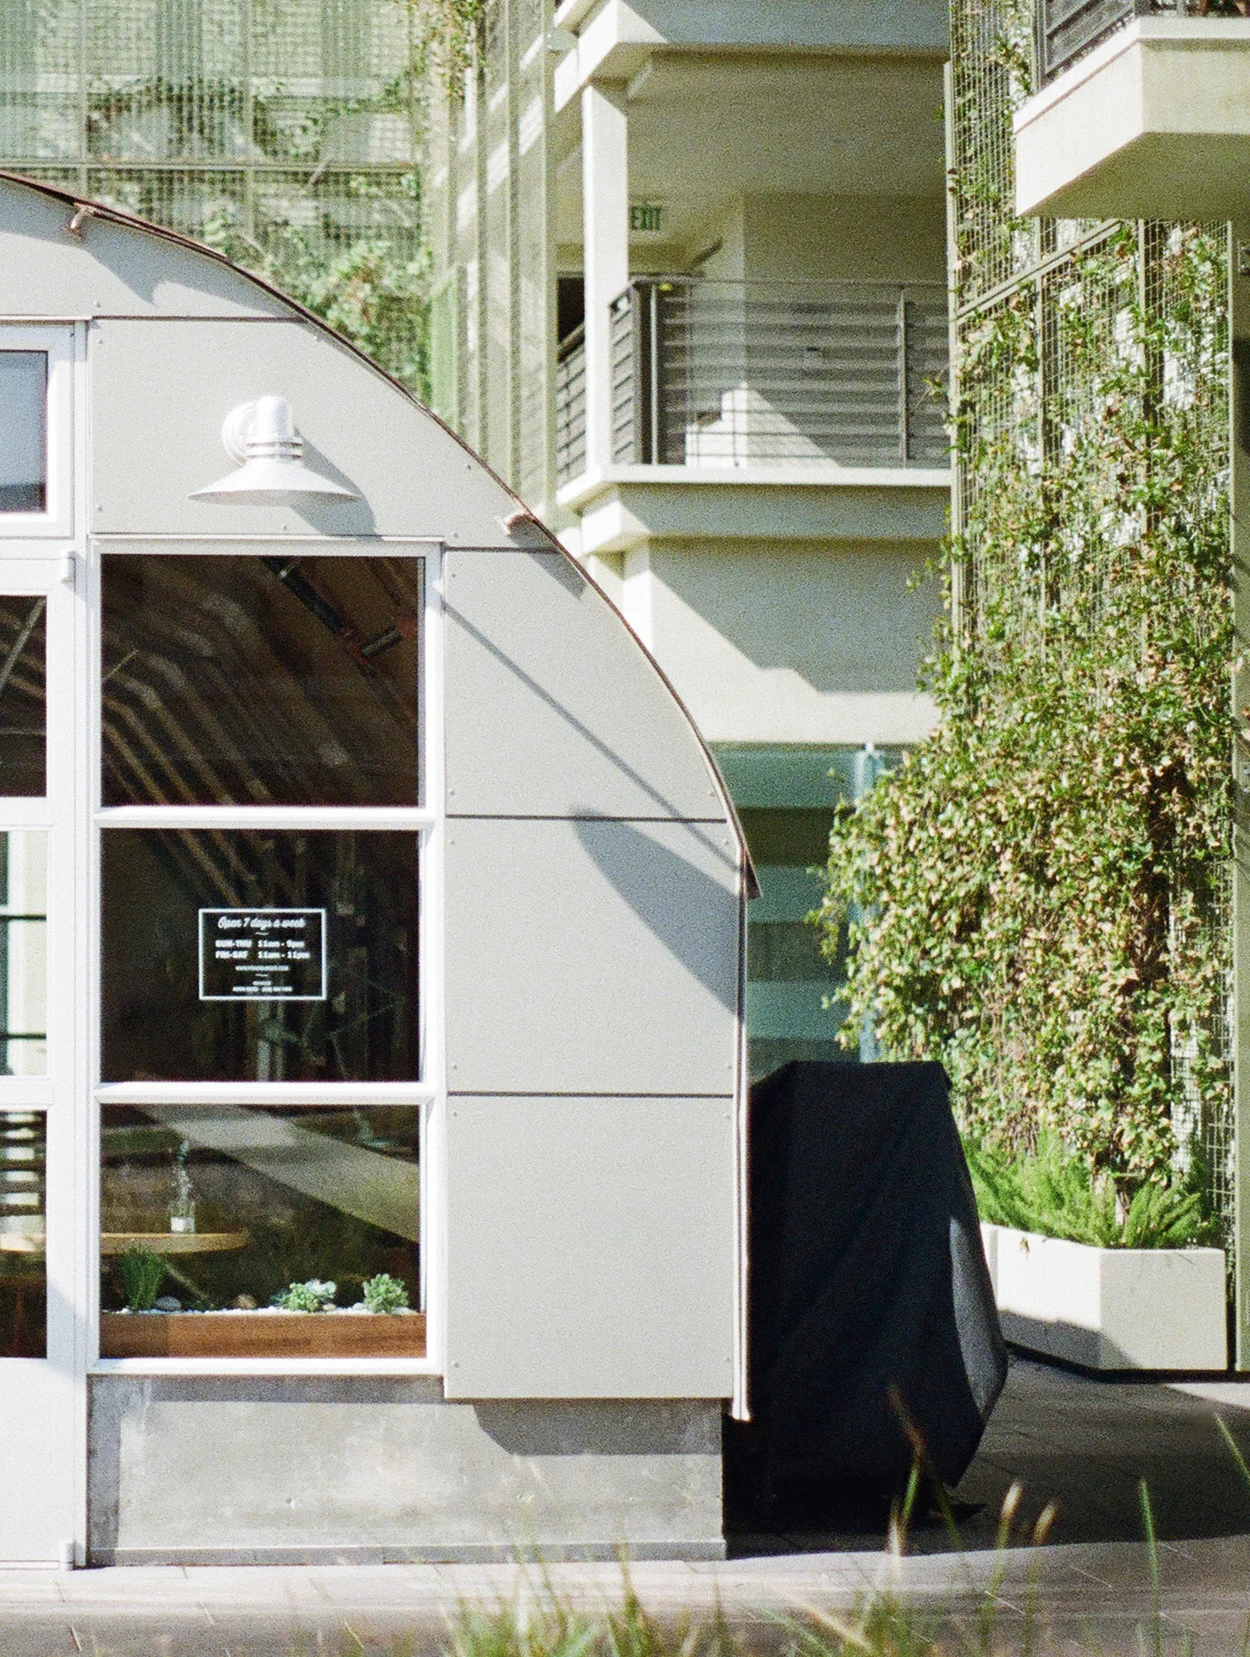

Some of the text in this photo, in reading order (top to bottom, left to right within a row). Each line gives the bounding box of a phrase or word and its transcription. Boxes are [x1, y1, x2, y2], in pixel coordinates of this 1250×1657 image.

[631, 206, 661, 231] EXIT
[217, 915, 242, 929] Open
[243, 917, 250, 927] 7
[250, 917, 272, 930] days
